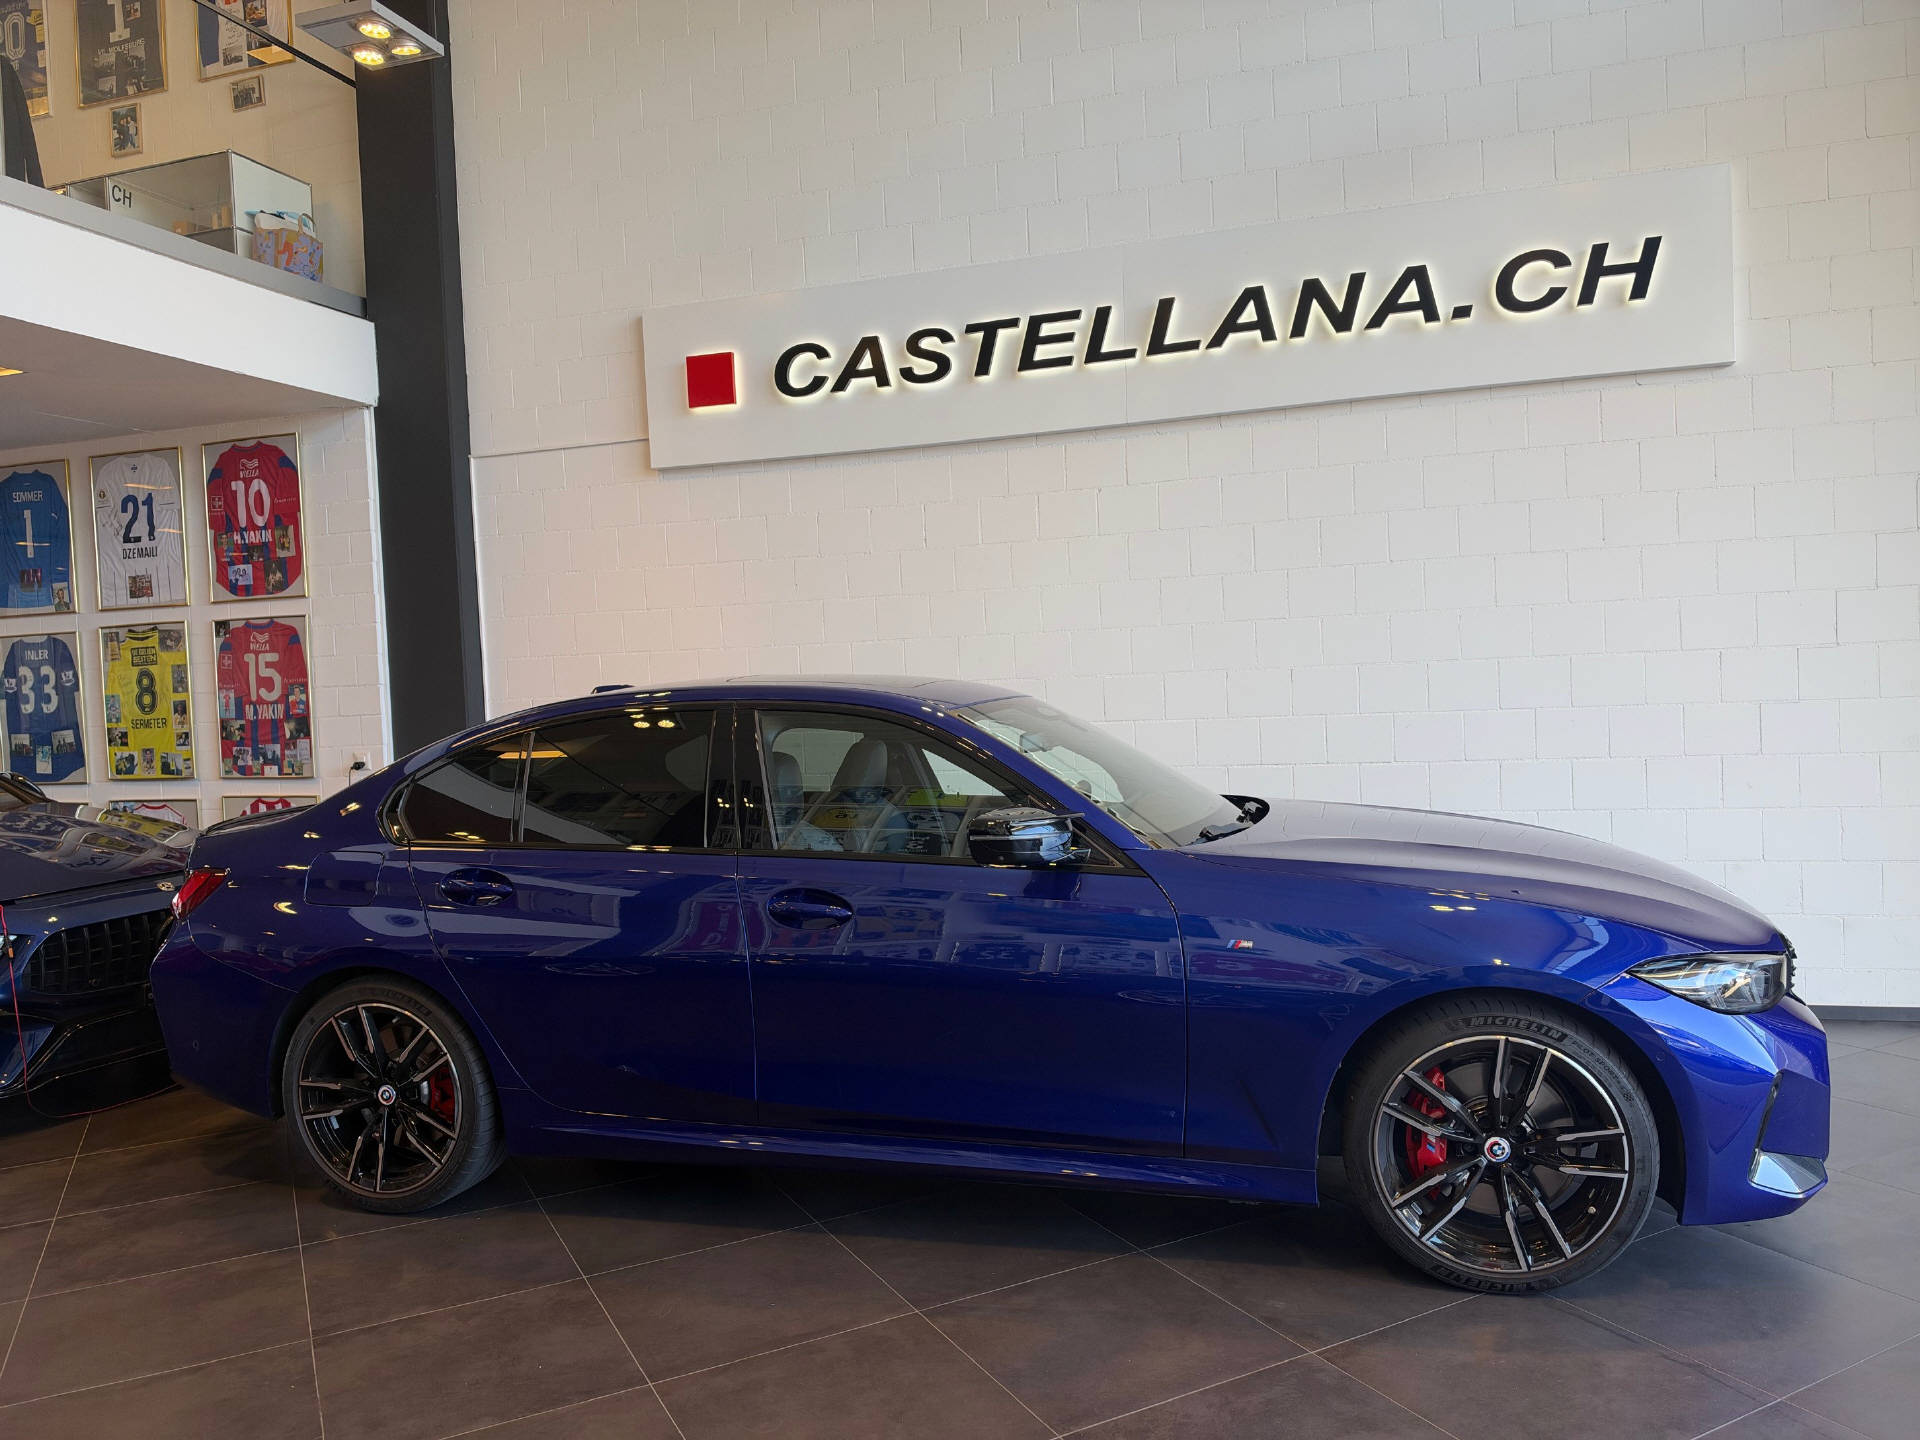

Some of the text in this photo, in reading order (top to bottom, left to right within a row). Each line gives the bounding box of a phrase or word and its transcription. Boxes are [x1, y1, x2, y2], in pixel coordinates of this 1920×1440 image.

[112, 185, 131, 208] CH
[774, 236, 1661, 398] CASTELLANA.CH
[13, 490, 43, 502] SOMMER
[121, 492, 155, 543] 21
[231, 479, 270, 528] 10
[24, 509, 34, 558] 1
[122, 546, 158, 560] DZEMAILI
[25, 649, 49, 660] INLER
[244, 653, 282, 701] 15
[19, 665, 58, 713] 33
[136, 668, 158, 715] 8
[131, 718, 167, 729] SERMETER
[1470, 1016, 1564, 1041] MICHELIN
